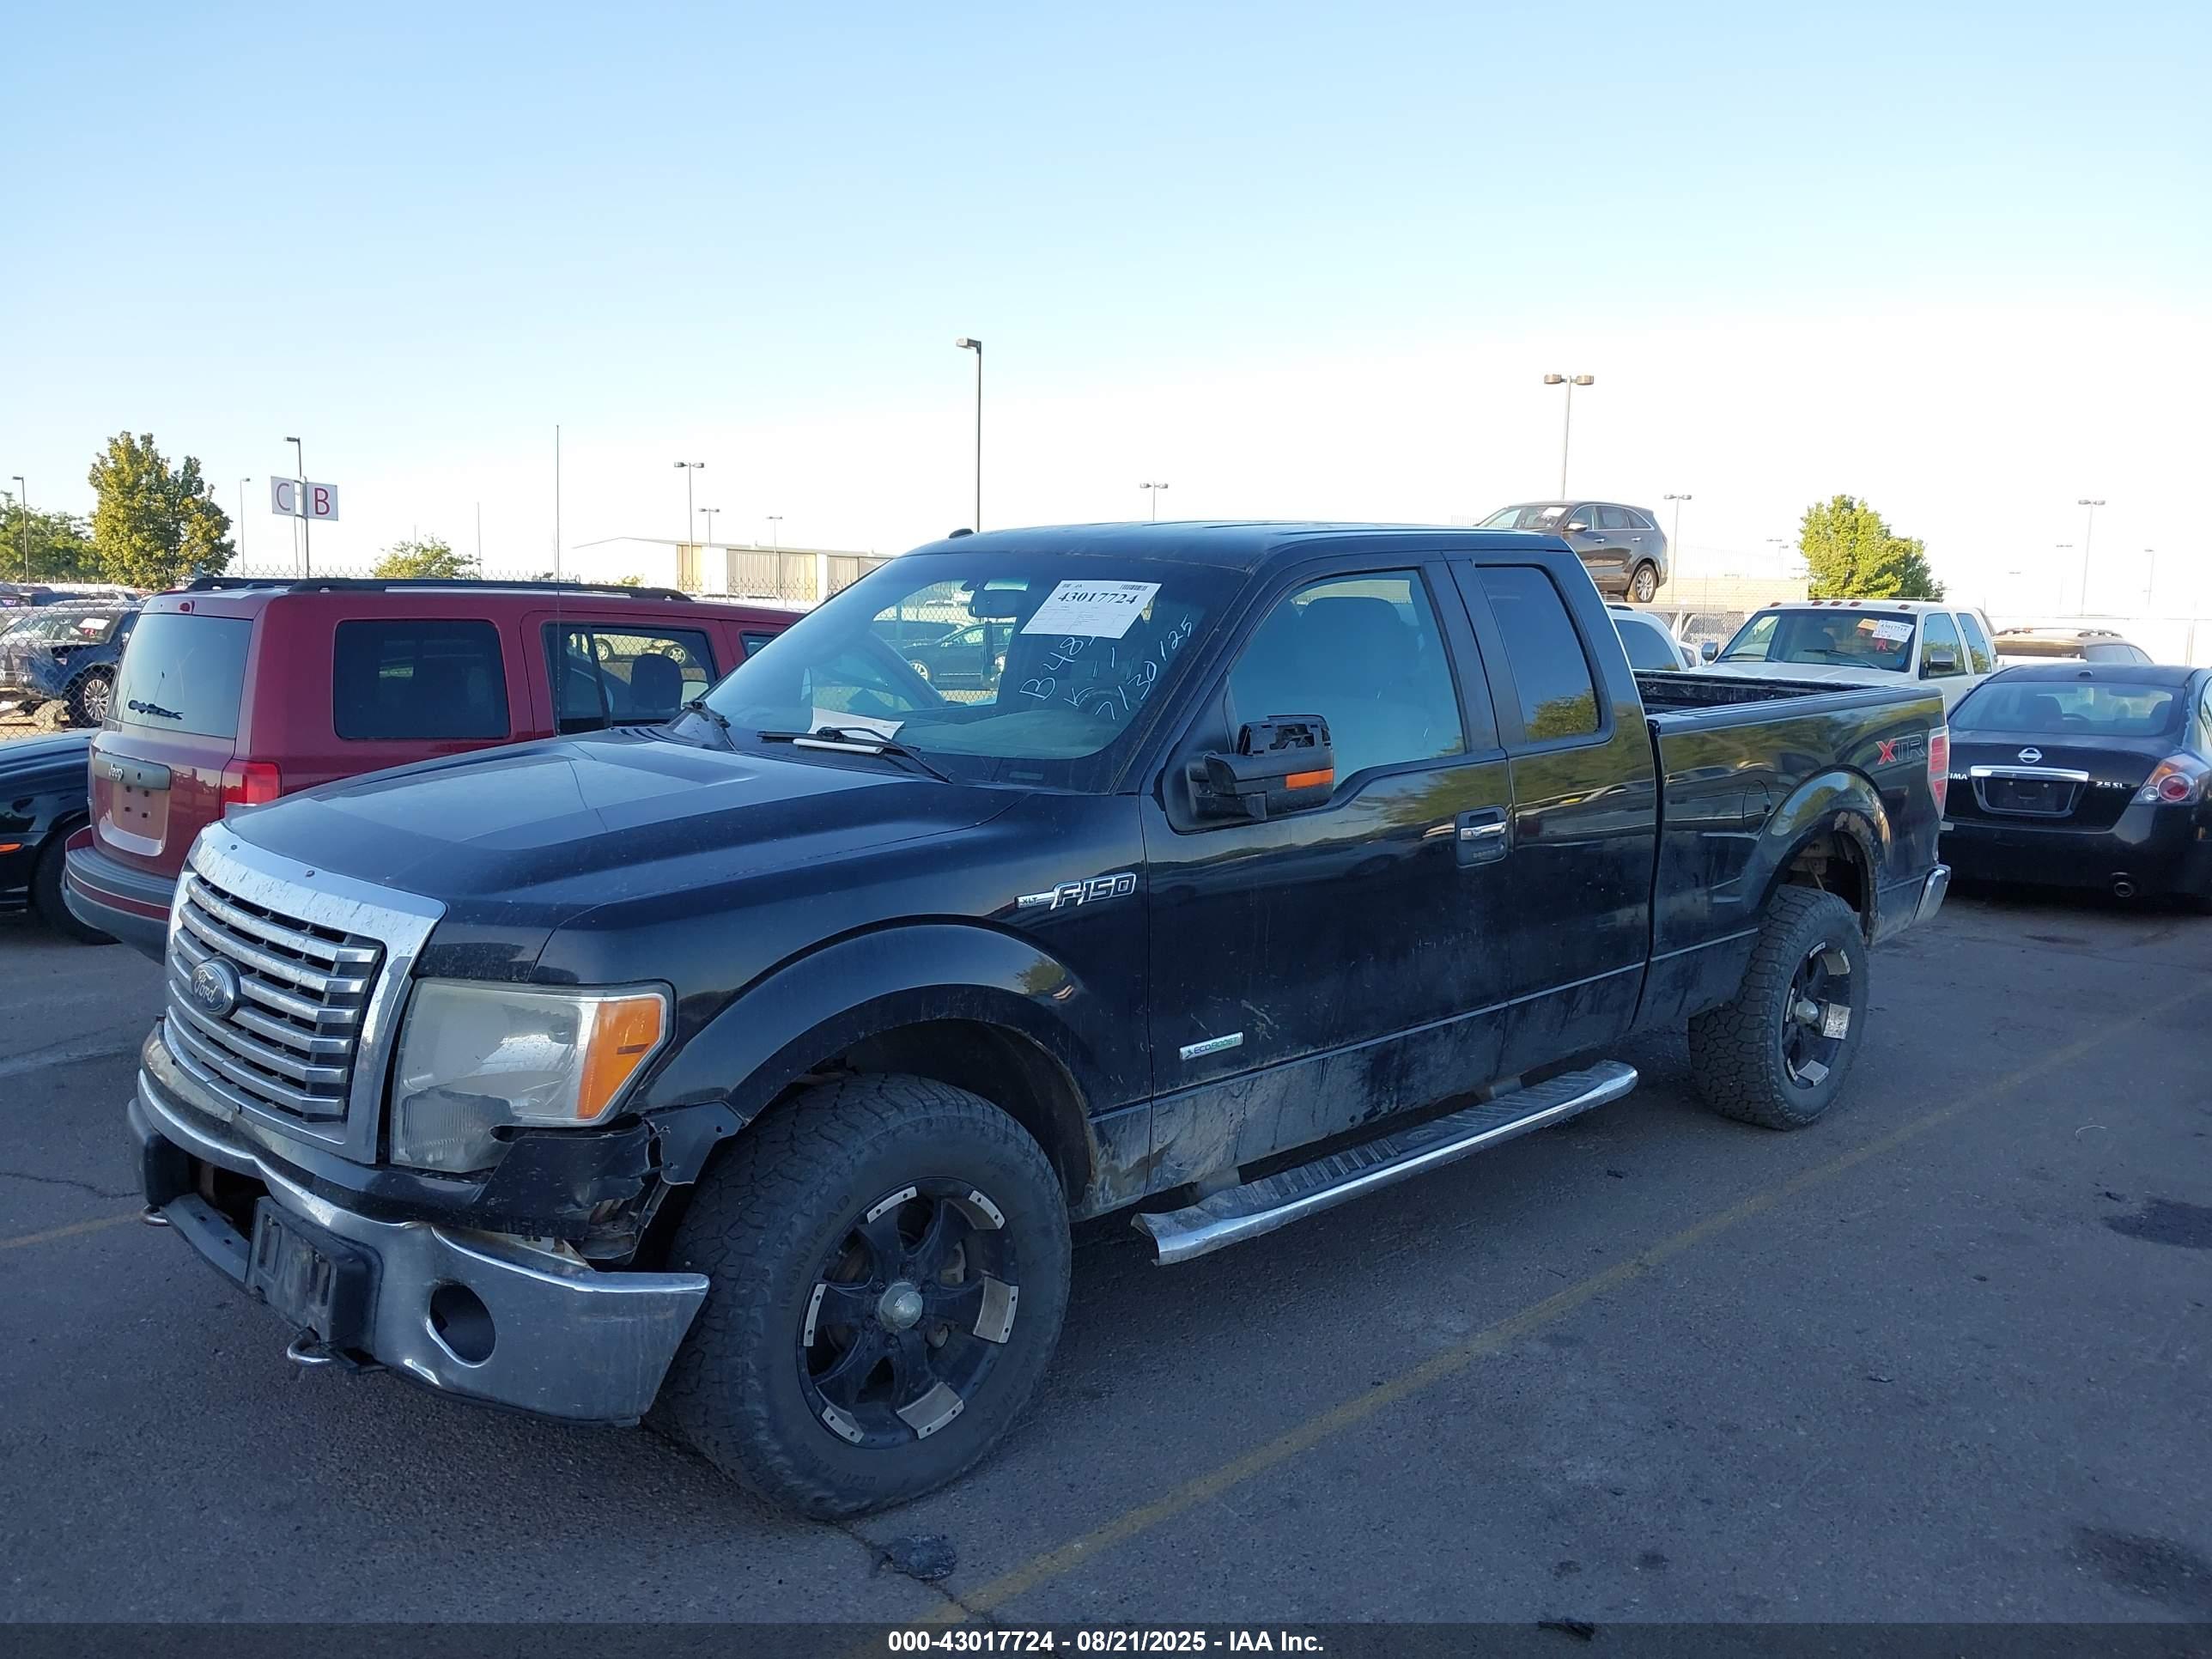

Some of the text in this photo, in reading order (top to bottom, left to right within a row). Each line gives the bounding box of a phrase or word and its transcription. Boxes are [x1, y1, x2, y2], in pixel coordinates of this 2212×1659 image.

[276, 483, 290, 512] C
[314, 487, 331, 515] B
[1057, 591, 1139, 605] 43017724
[1019, 635, 1096, 701] B48
[1875, 734, 1925, 765] XTR
[1949, 772, 1968, 781] IMA
[1021, 896, 1038, 905] XLT
[194, 969, 218, 1004] Ford
